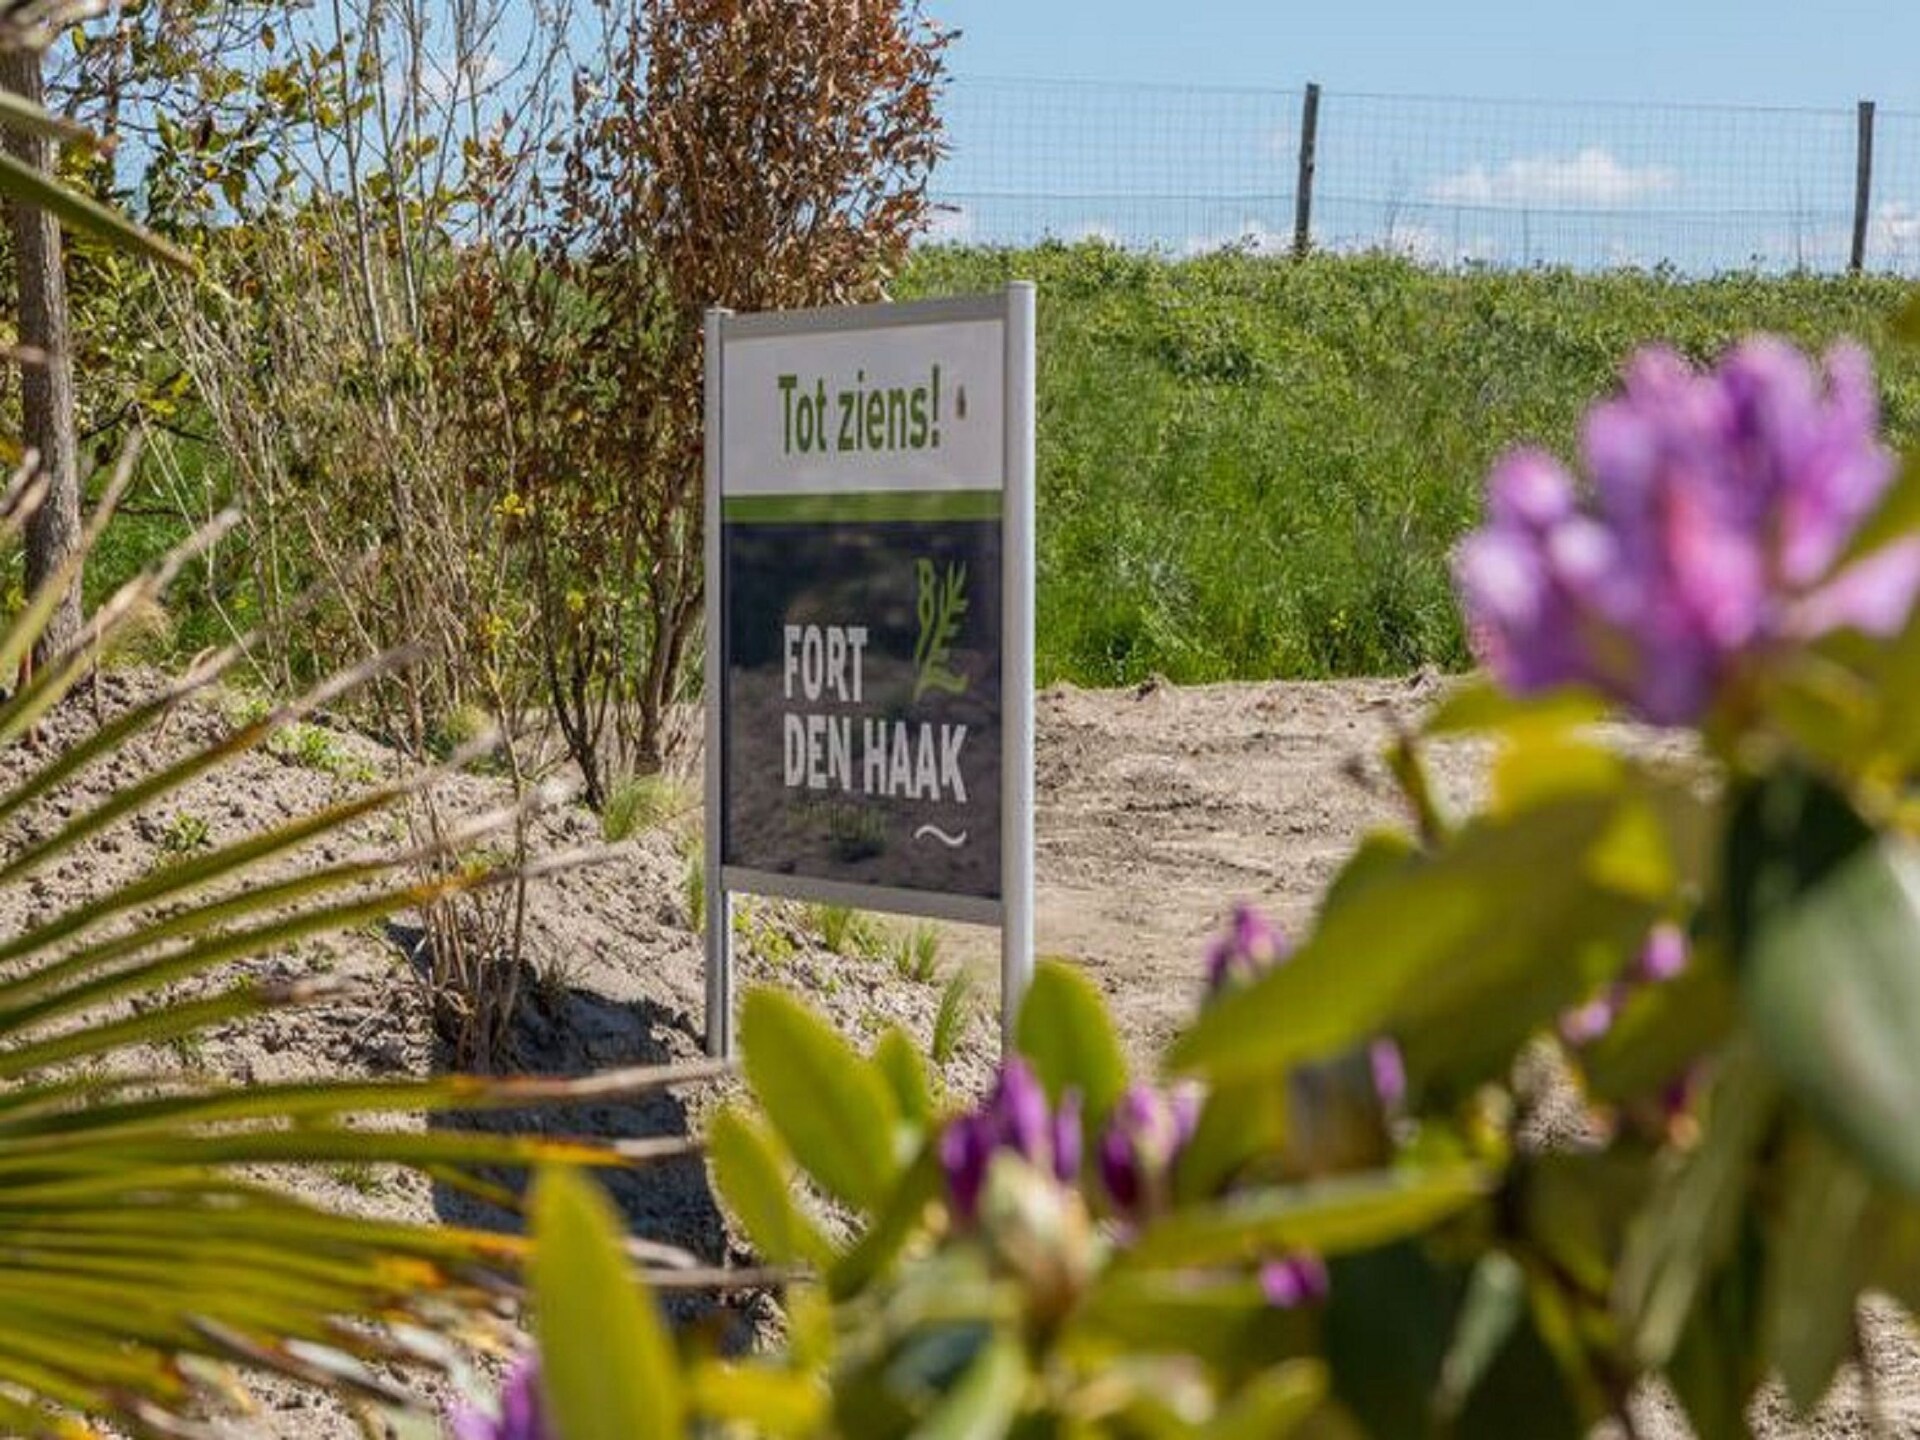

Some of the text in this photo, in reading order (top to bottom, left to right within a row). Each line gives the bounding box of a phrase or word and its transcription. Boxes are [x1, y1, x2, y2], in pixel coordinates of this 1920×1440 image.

[778, 364, 940, 454] Tot ziens!
[783, 625, 868, 702] FORT
[783, 713, 967, 803] DEN HAAK
